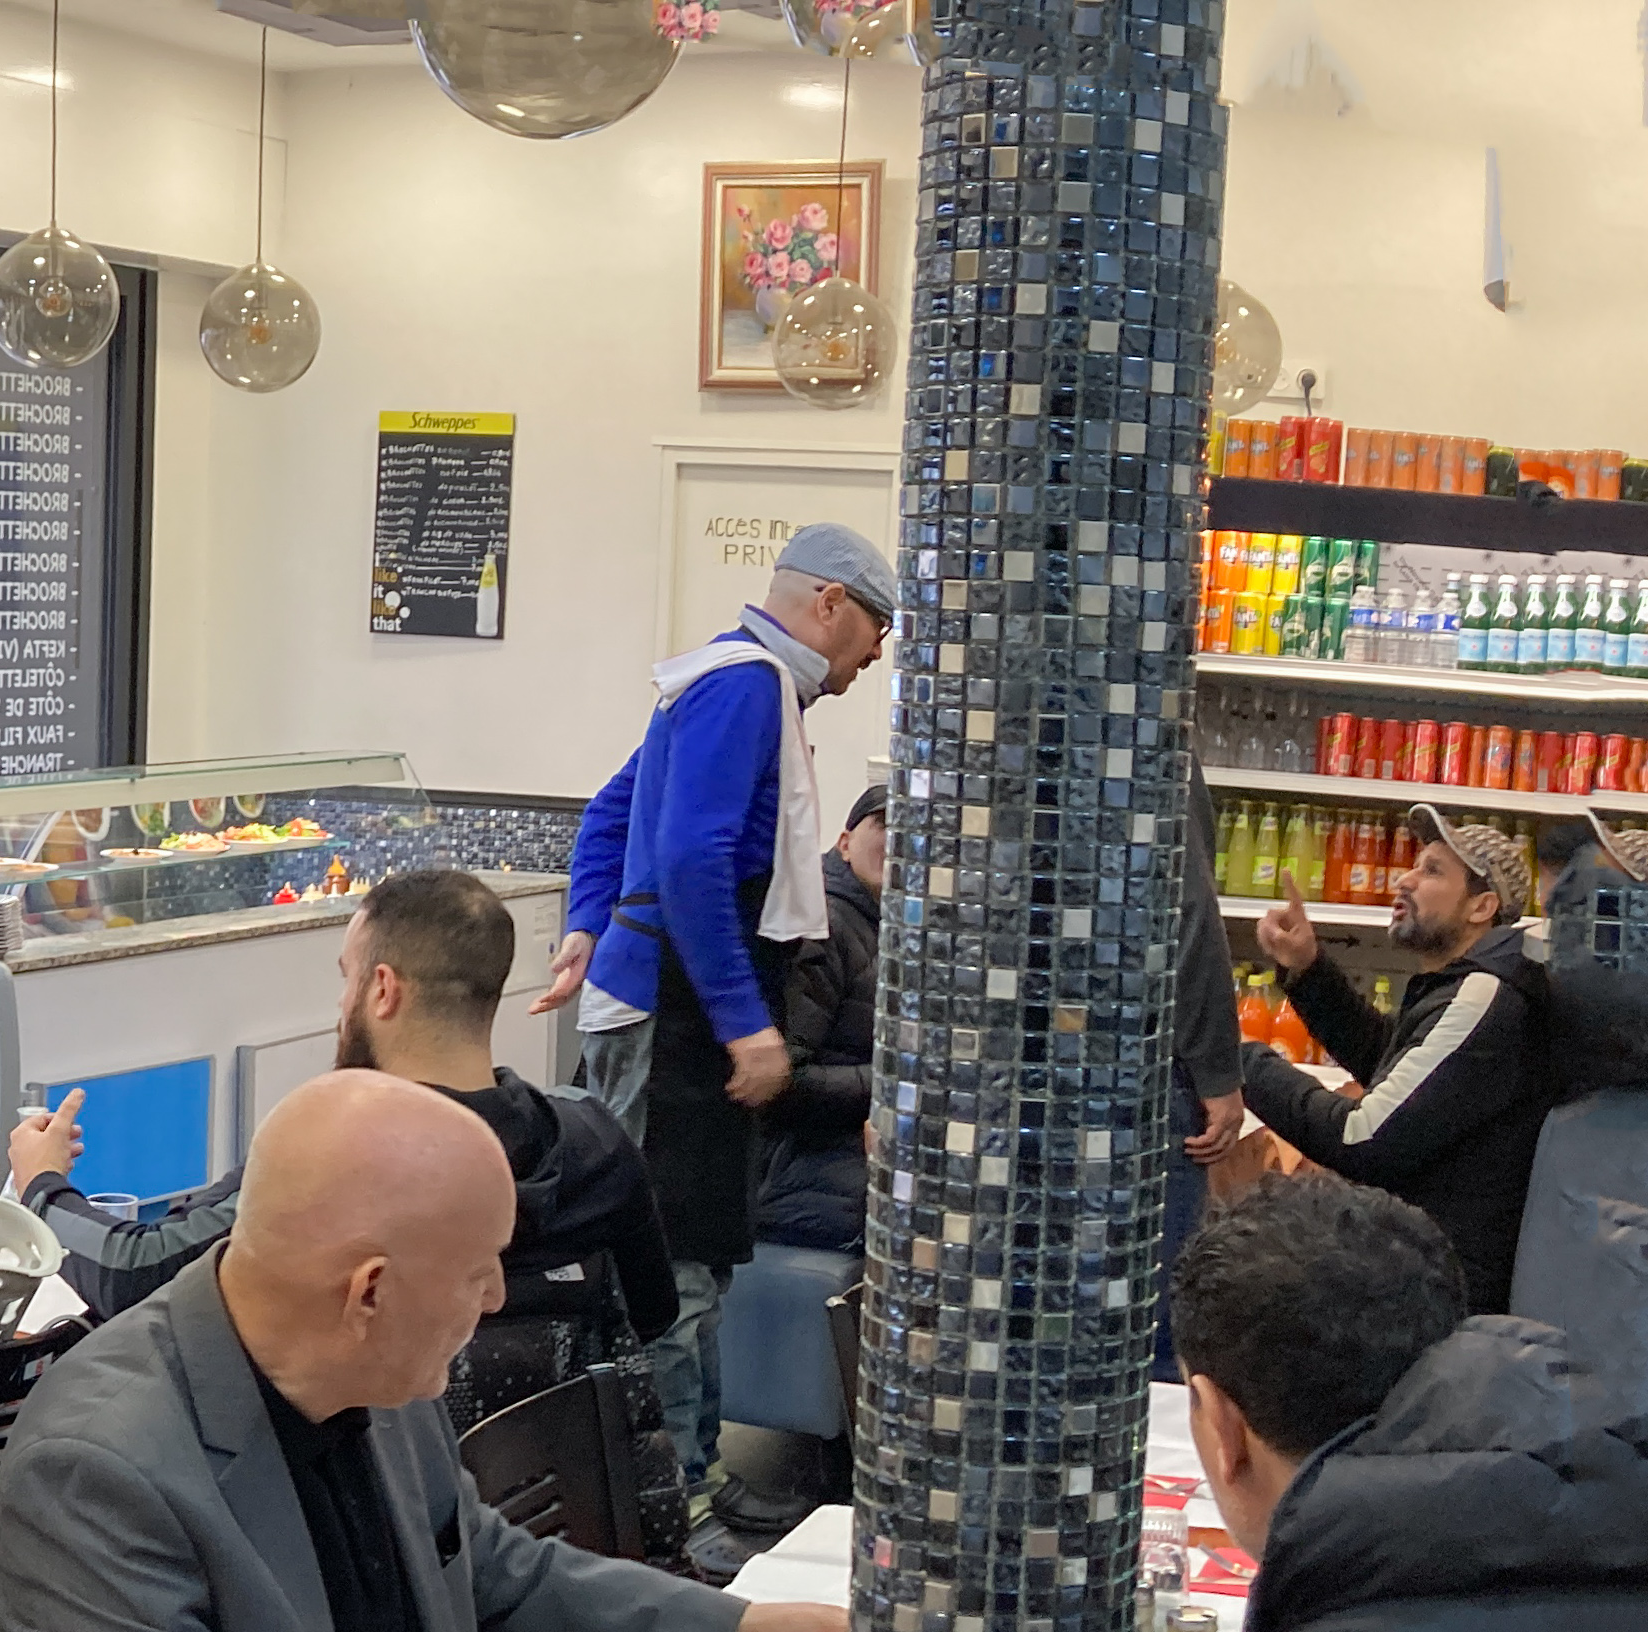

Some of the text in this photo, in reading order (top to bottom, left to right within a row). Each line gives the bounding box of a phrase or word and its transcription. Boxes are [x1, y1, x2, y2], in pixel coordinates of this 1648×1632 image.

[408, 412, 478, 432] Schweppes
[373, 566, 398, 583] like
[372, 583, 385, 598] it
[372, 601, 397, 616] like
[372, 616, 403, 632] that
